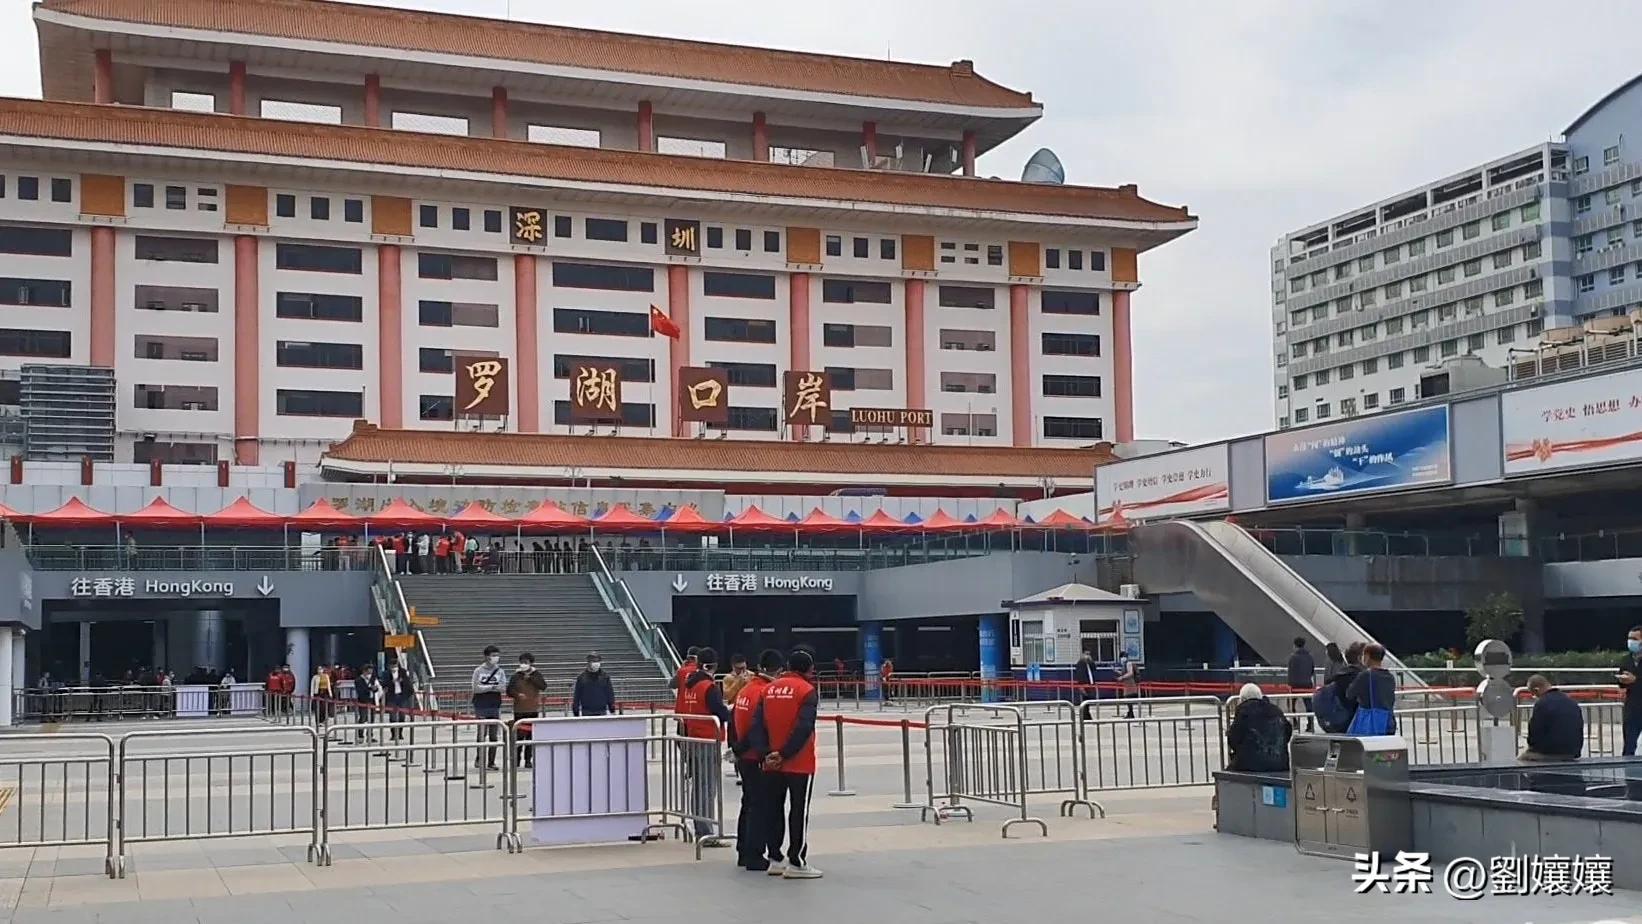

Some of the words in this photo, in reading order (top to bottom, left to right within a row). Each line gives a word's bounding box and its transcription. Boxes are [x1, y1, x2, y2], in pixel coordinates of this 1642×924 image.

[1582, 399, 1620, 416] 悟思想
[852, 410, 895, 423] LUOHU
[901, 411, 932, 424] PORT
[71, 576, 136, 597] 往香港
[145, 579, 234, 596] HongKong
[707, 574, 758, 591] 往香港
[764, 576, 833, 591] HongKong
